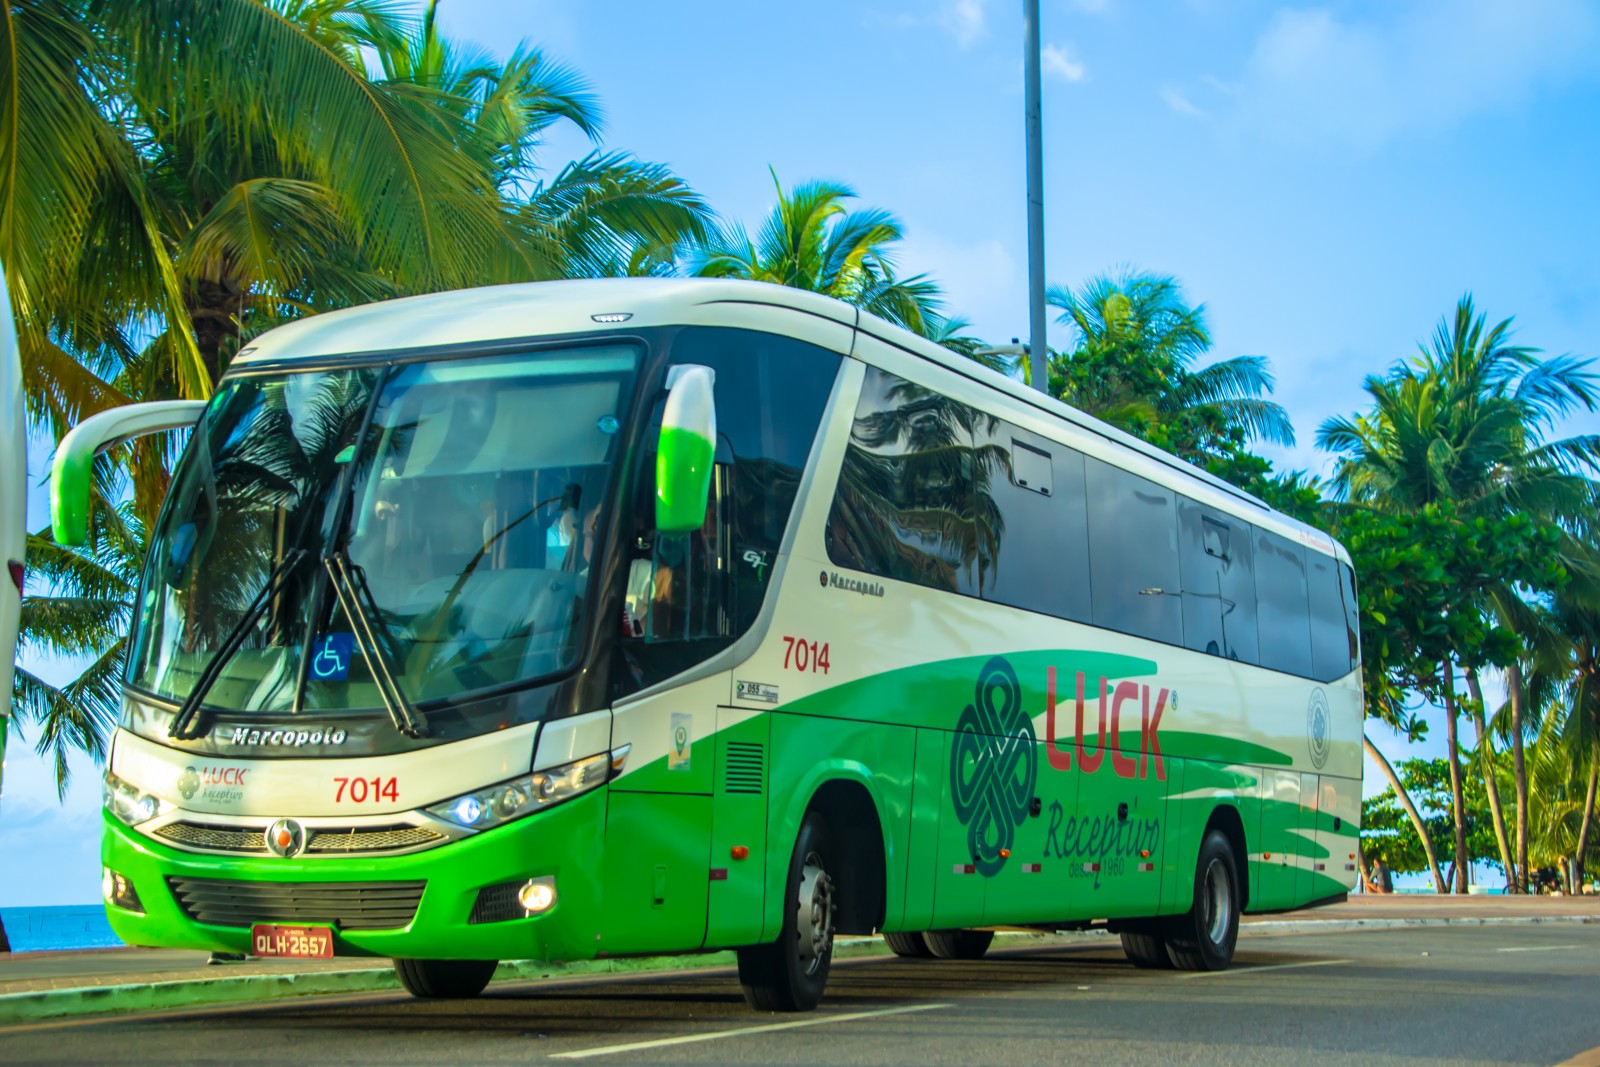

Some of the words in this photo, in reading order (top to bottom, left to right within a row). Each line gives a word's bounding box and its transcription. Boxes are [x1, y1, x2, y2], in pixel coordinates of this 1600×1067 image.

[829, 571, 885, 597] Marcopolo
[783, 635, 830, 675] 7014
[1046, 665, 1170, 782] LUCK
[231, 726, 348, 748] Marcopolo
[203, 766, 247, 786] LUCK
[333, 776, 399, 804] 7014
[1103, 857, 1125, 877] 1960
